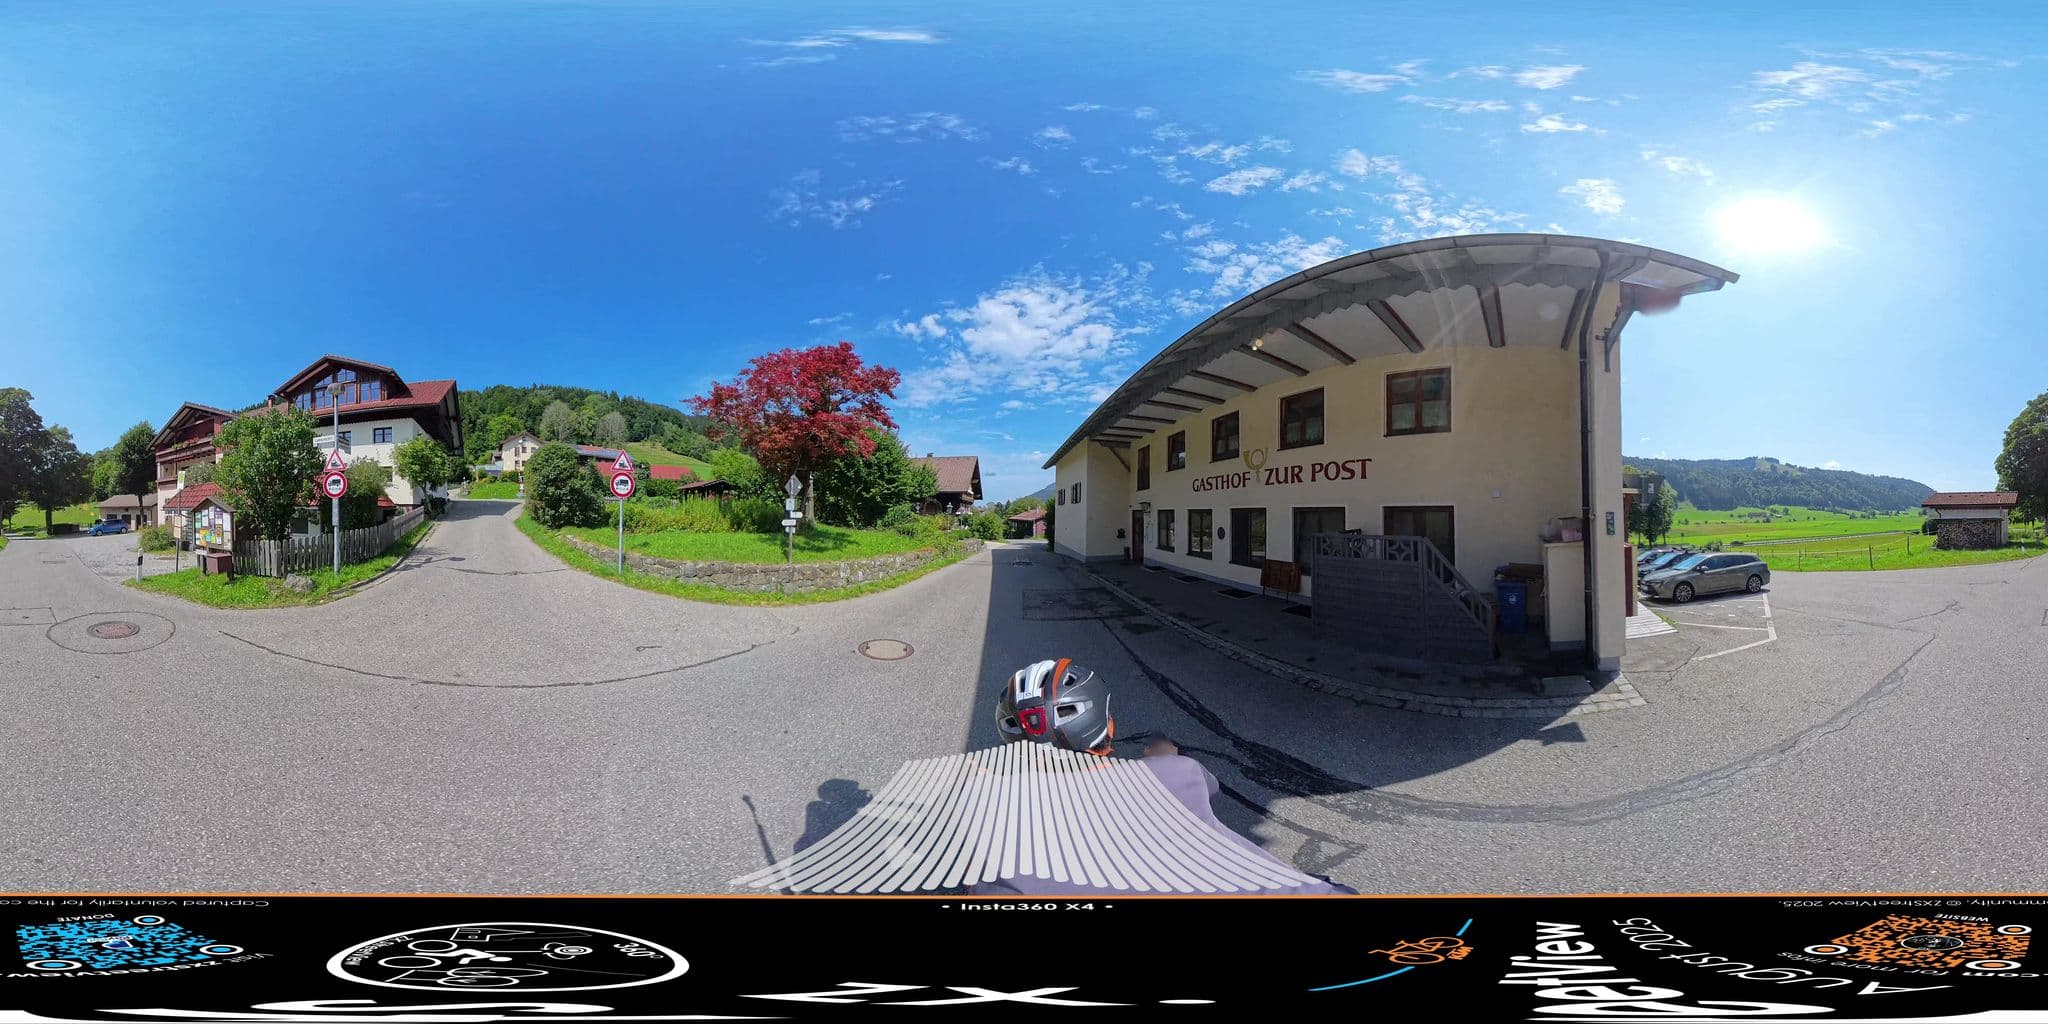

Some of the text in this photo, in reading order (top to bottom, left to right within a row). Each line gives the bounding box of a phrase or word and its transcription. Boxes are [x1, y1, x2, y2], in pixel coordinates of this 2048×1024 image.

[1192, 458, 1372, 493] GASTHOF ZUR POST
